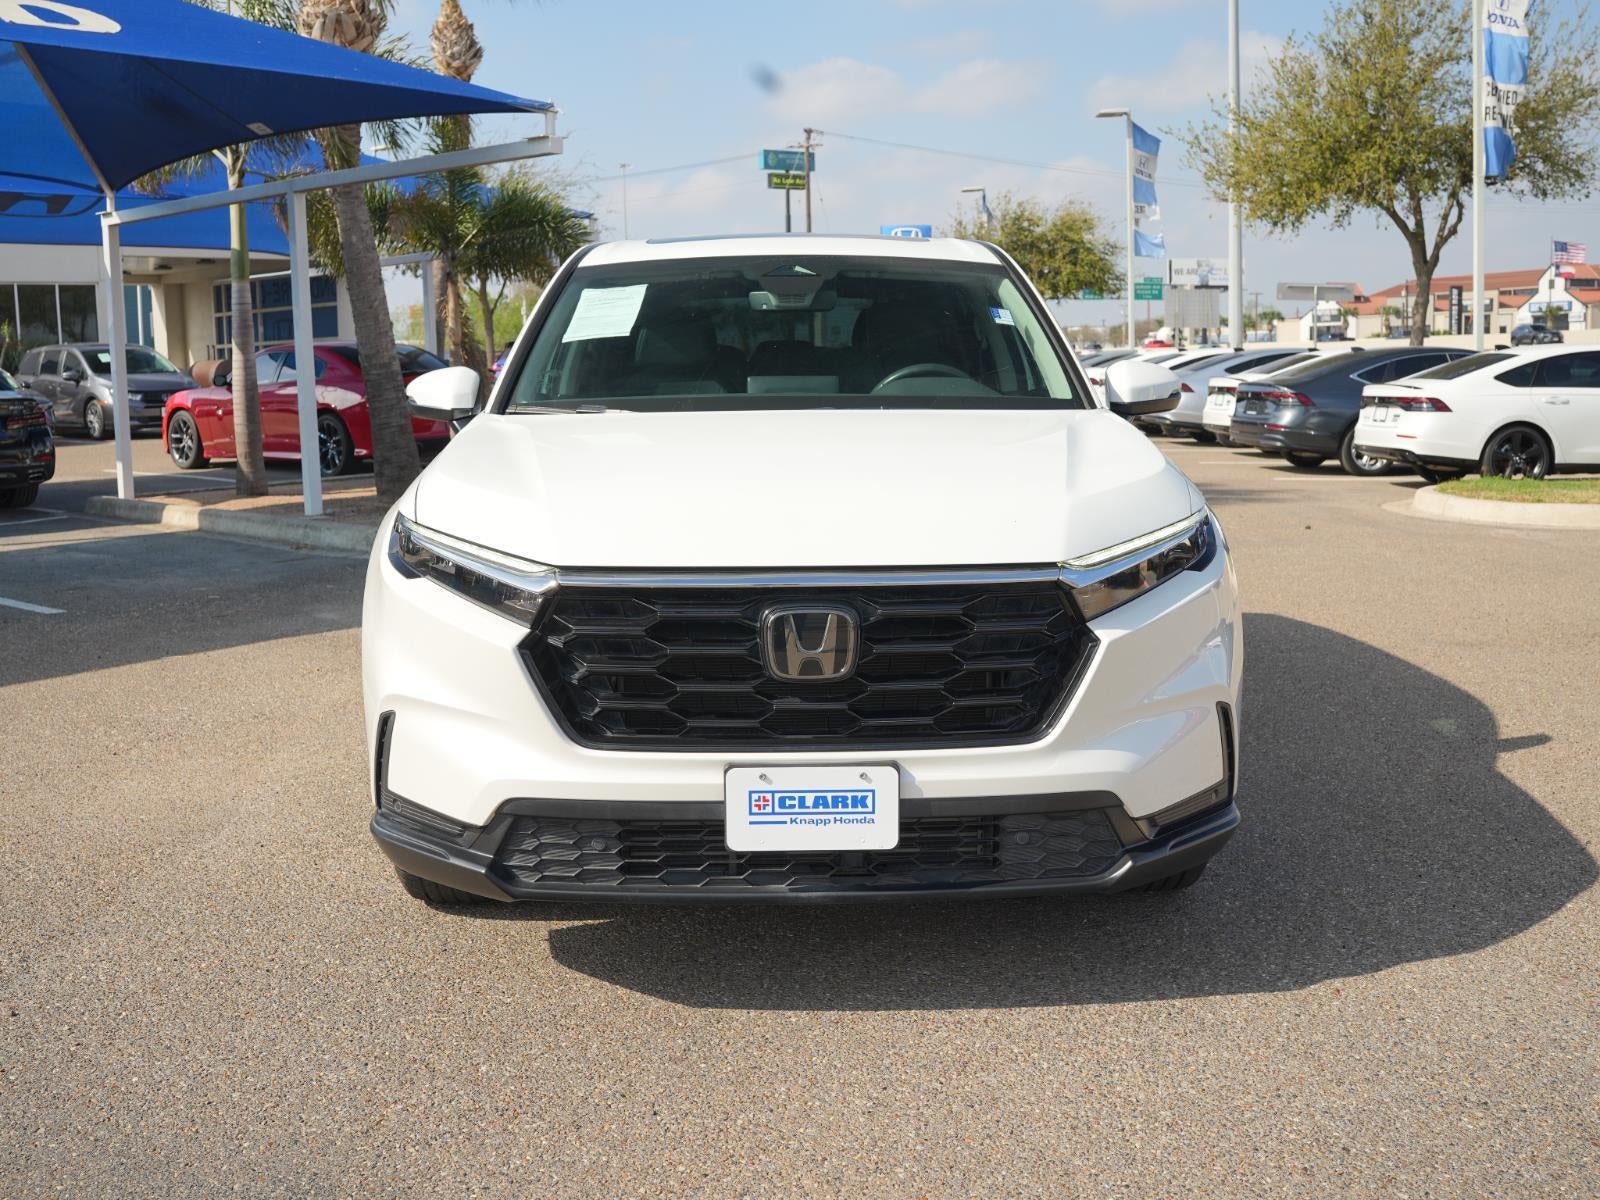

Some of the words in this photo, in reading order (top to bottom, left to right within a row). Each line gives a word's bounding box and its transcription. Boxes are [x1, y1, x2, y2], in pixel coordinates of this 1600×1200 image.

[778, 795, 870, 810] CLARK
[790, 817, 831, 826] Knapp
[833, 816, 875, 825] Honda
